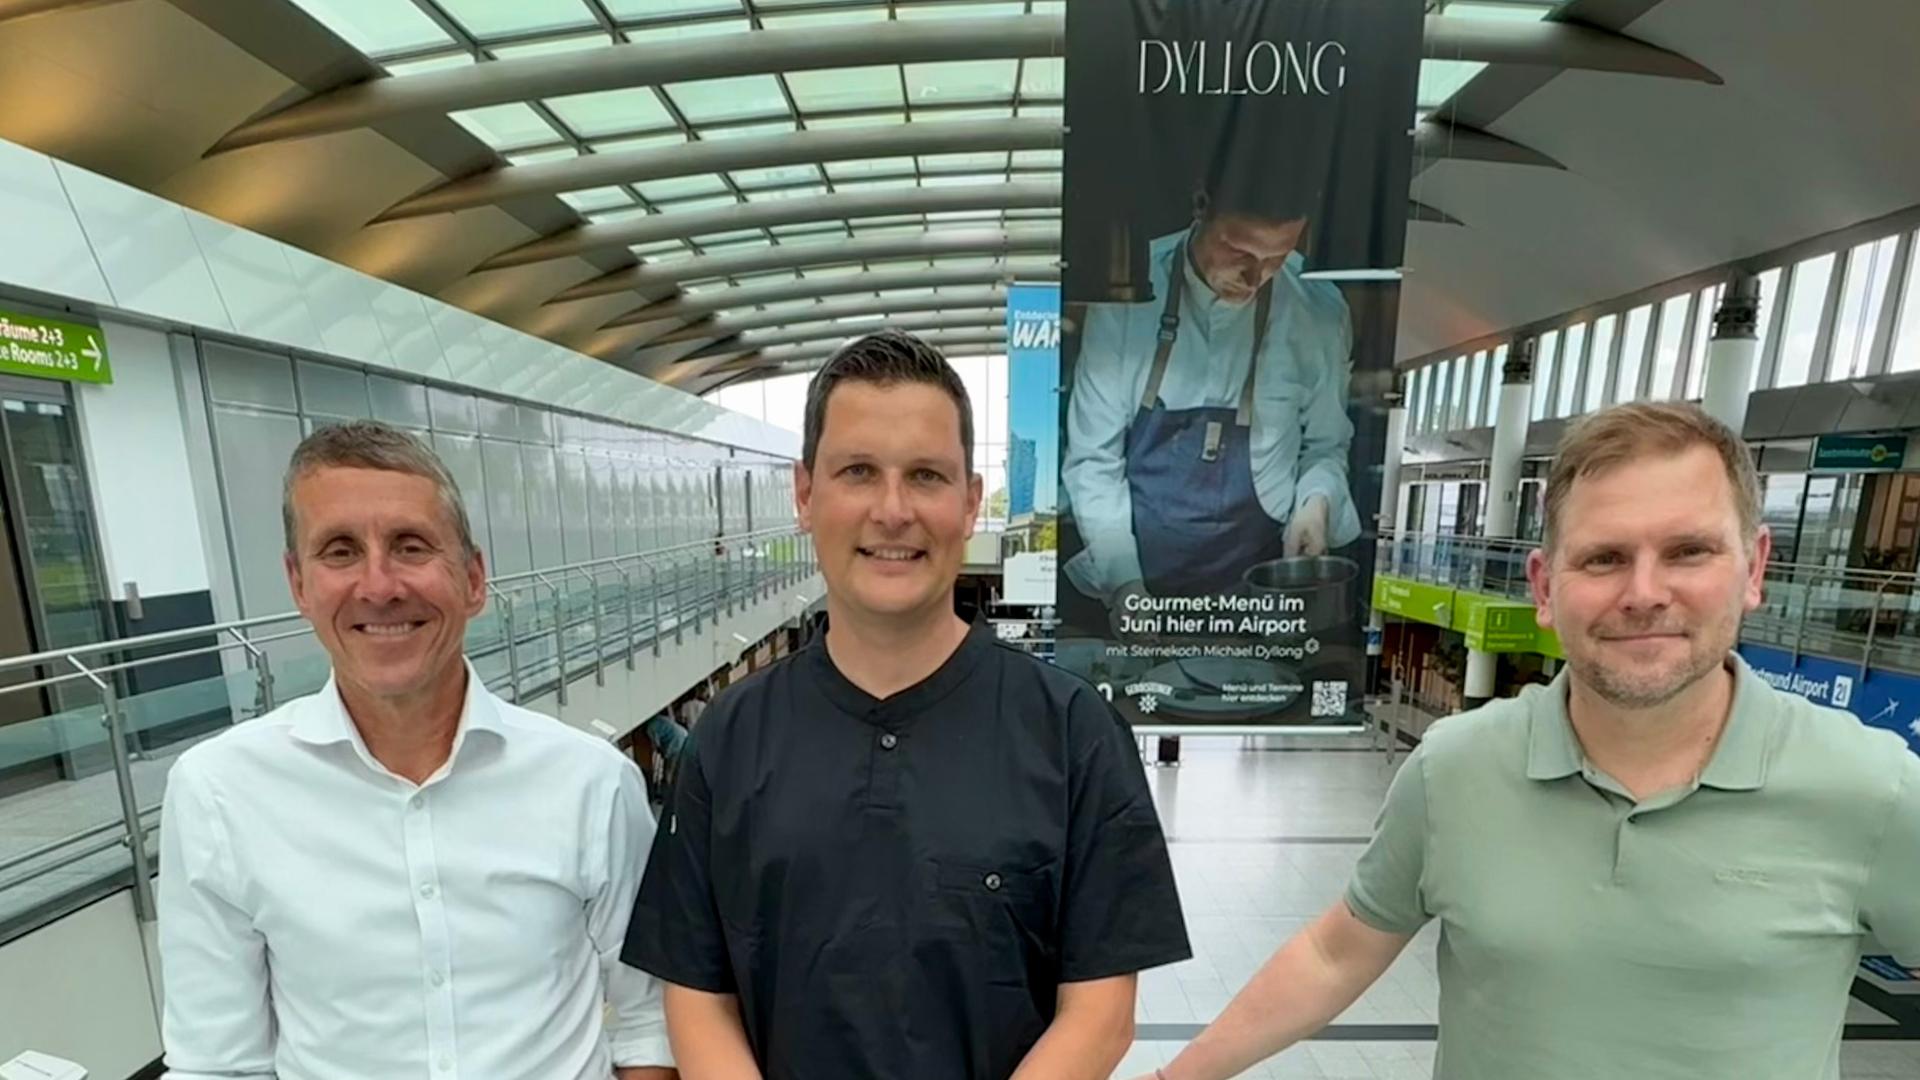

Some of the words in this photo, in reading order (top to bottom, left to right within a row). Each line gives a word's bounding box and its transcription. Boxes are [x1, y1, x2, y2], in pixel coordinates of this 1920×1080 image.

[1138, 39, 1347, 95] DYLLONG
[38, 325, 64, 347] 2+3
[10, 342, 54, 367] Rooms
[54, 350, 79, 370] 2+3
[1124, 593, 1275, 612] Gourmet-Menü
[1279, 593, 1305, 612] im
[1119, 616, 1162, 633] Juni
[1166, 616, 1204, 633] hier
[1209, 616, 1234, 633] im
[1238, 616, 1307, 636] Airport
[1105, 643, 1128, 657] mit
[1130, 643, 1202, 657] Sternekoch
[1203, 643, 1253, 657] Michael
[1255, 644, 1304, 660] Dyllong
[1249, 682, 1267, 692] und
[1790, 672, 1830, 701] Airport
[1834, 682, 1848, 703] 21
